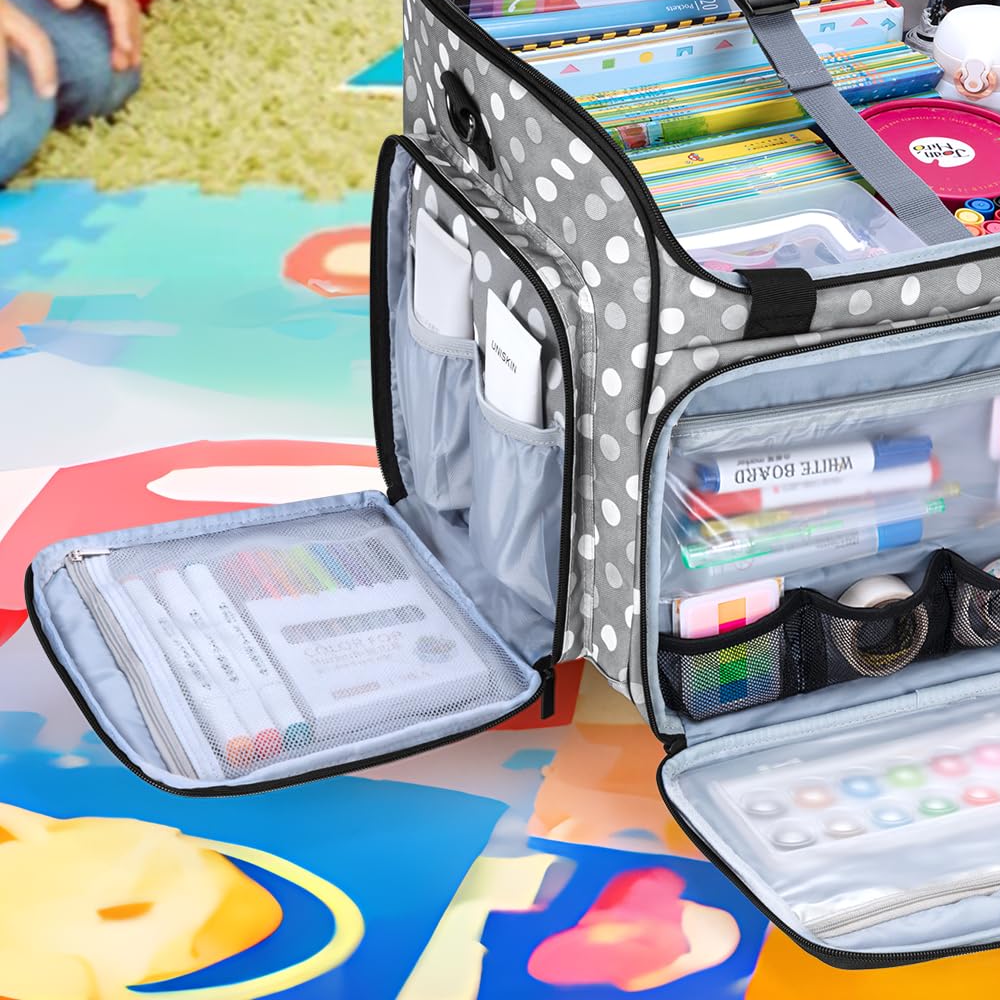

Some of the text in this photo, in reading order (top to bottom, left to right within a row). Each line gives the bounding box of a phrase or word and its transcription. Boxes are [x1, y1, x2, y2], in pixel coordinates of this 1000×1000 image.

[665, 0, 719, 12] 20 Pockets
[925, 147, 970, 159] Joan
[490, 339, 518, 374] UNISKIN
[735, 463, 795, 485] BOARD
[801, 456, 854, 476] WHITE
